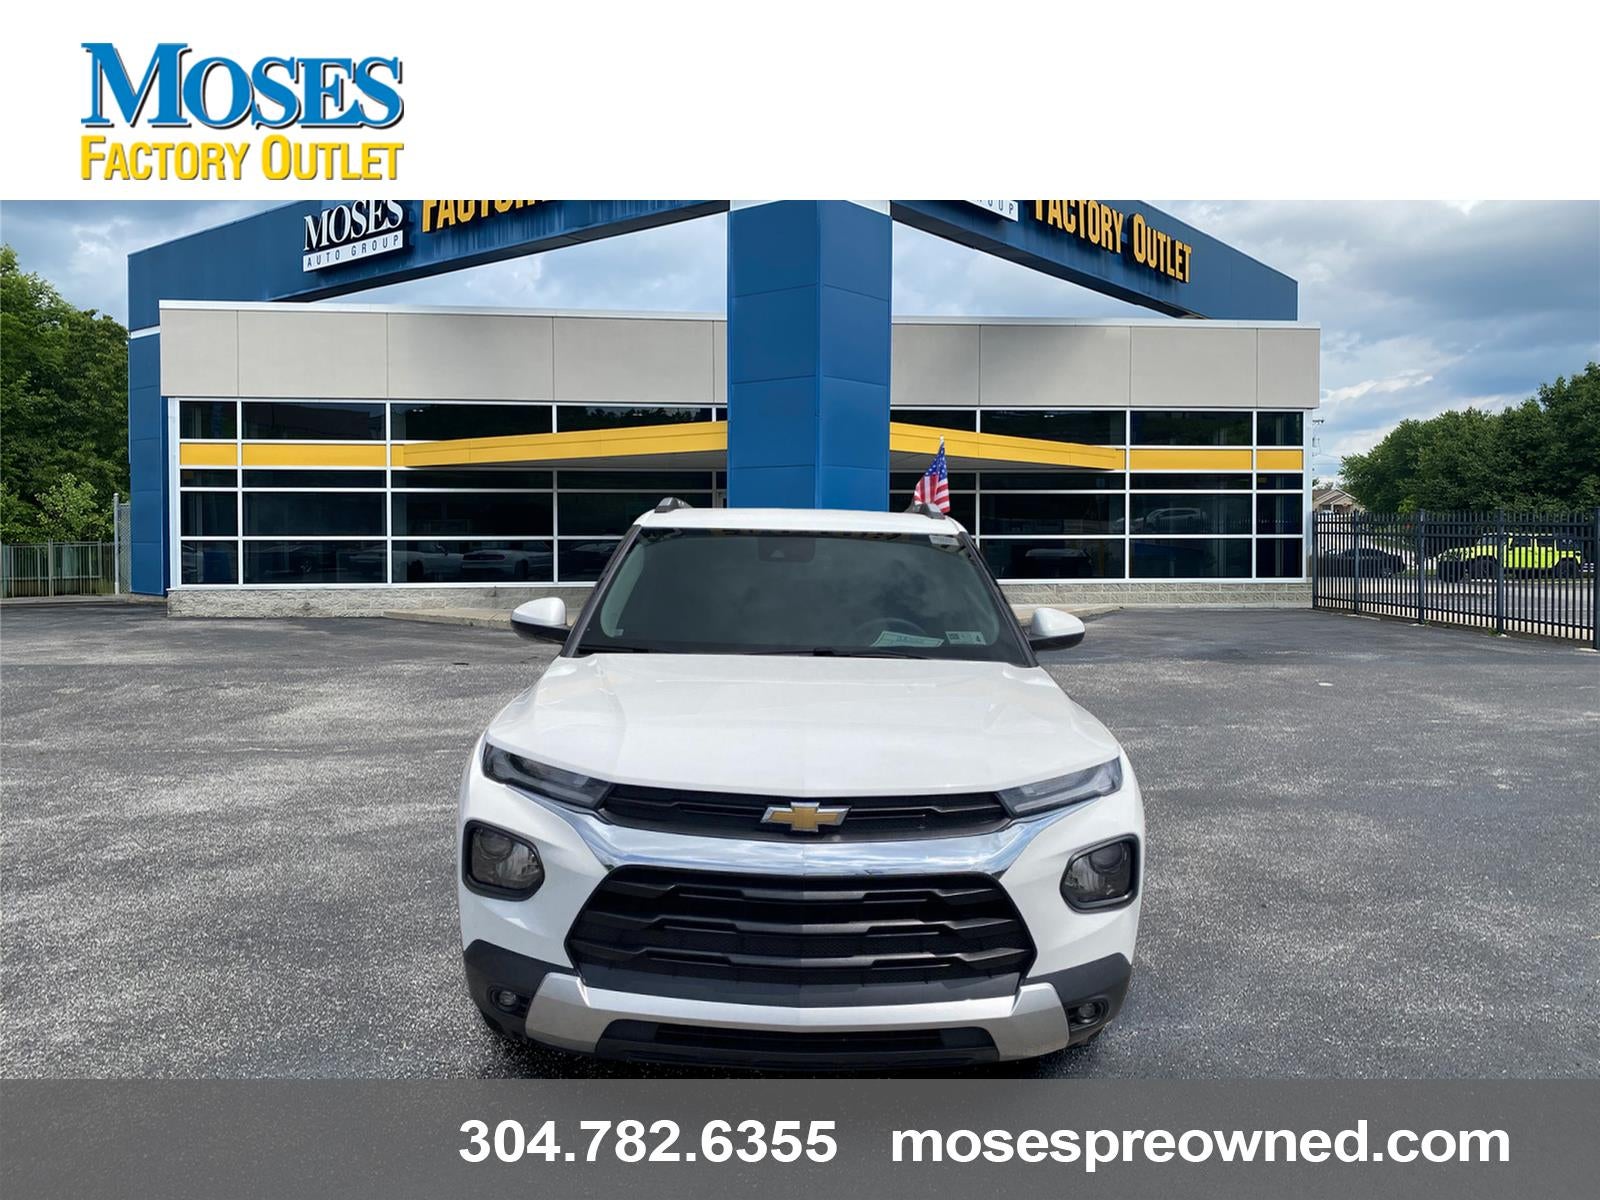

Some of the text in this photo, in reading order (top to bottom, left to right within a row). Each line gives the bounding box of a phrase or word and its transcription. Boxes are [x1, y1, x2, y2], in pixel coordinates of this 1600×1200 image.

[303, 200, 403, 251] MOSES
[307, 235, 399, 267] AUTO GROUP
[1132, 213, 1192, 283] OUTLET
